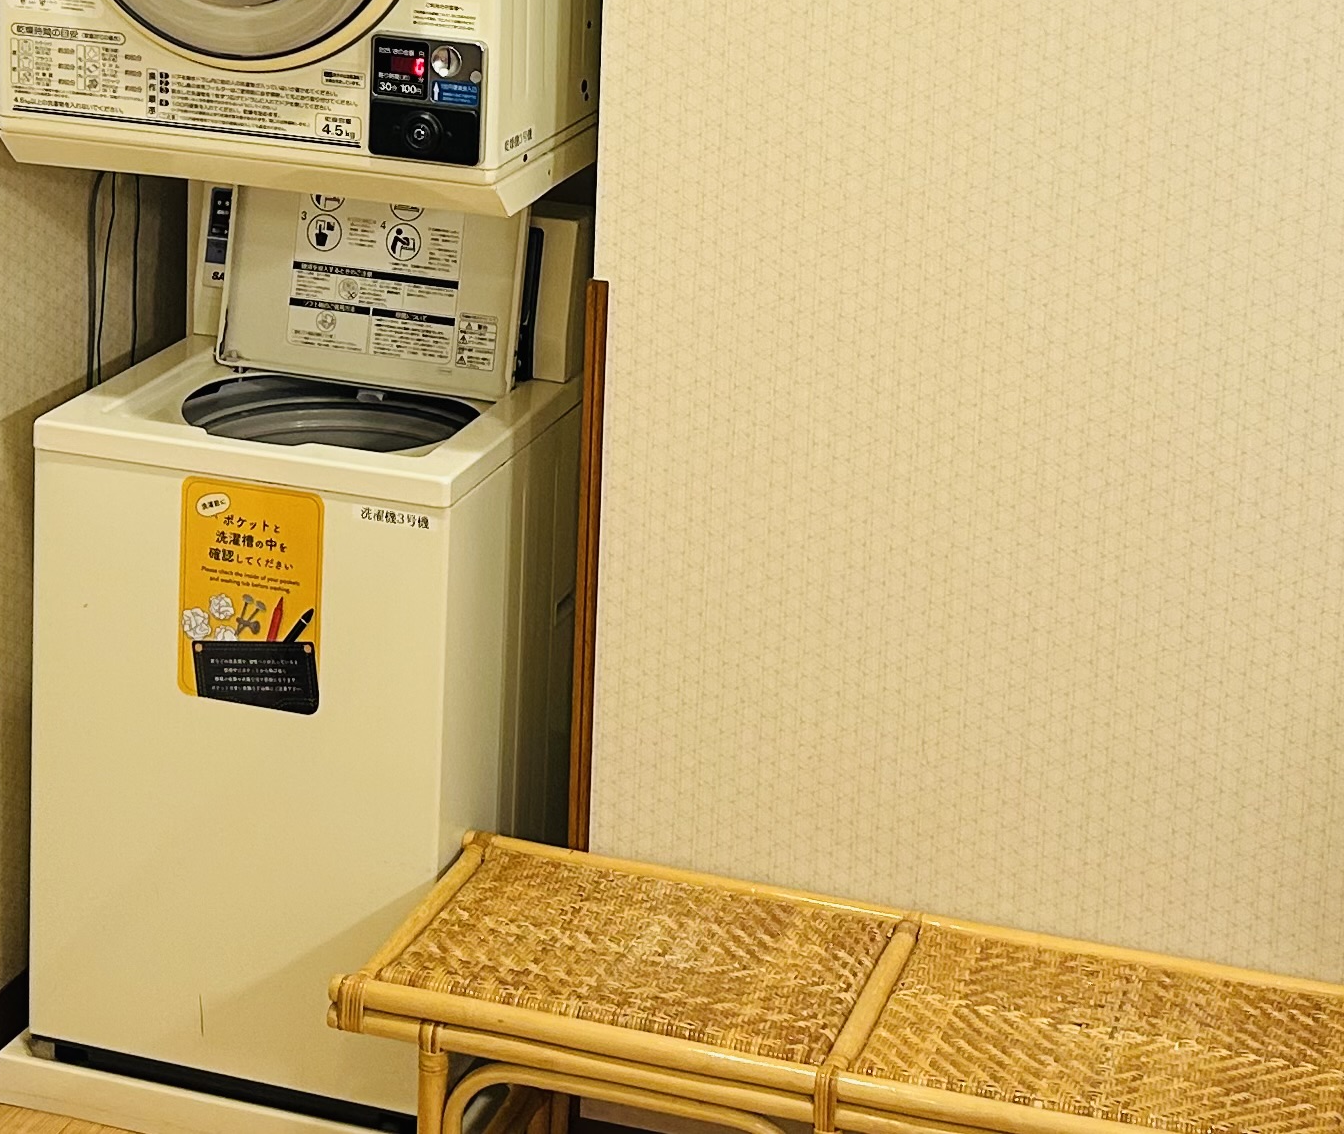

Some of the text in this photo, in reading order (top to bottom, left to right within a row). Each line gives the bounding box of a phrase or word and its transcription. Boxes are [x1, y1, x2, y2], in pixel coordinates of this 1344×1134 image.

[301, 211, 308, 221] 3
[380, 220, 387, 230] 4
[223, 514, 281, 534] ポケットと
[360, 506, 430, 530] 洗濯機3号機
[215, 529, 288, 553] 洗濯槽の中を
[208, 547, 294, 571] 確認してください
